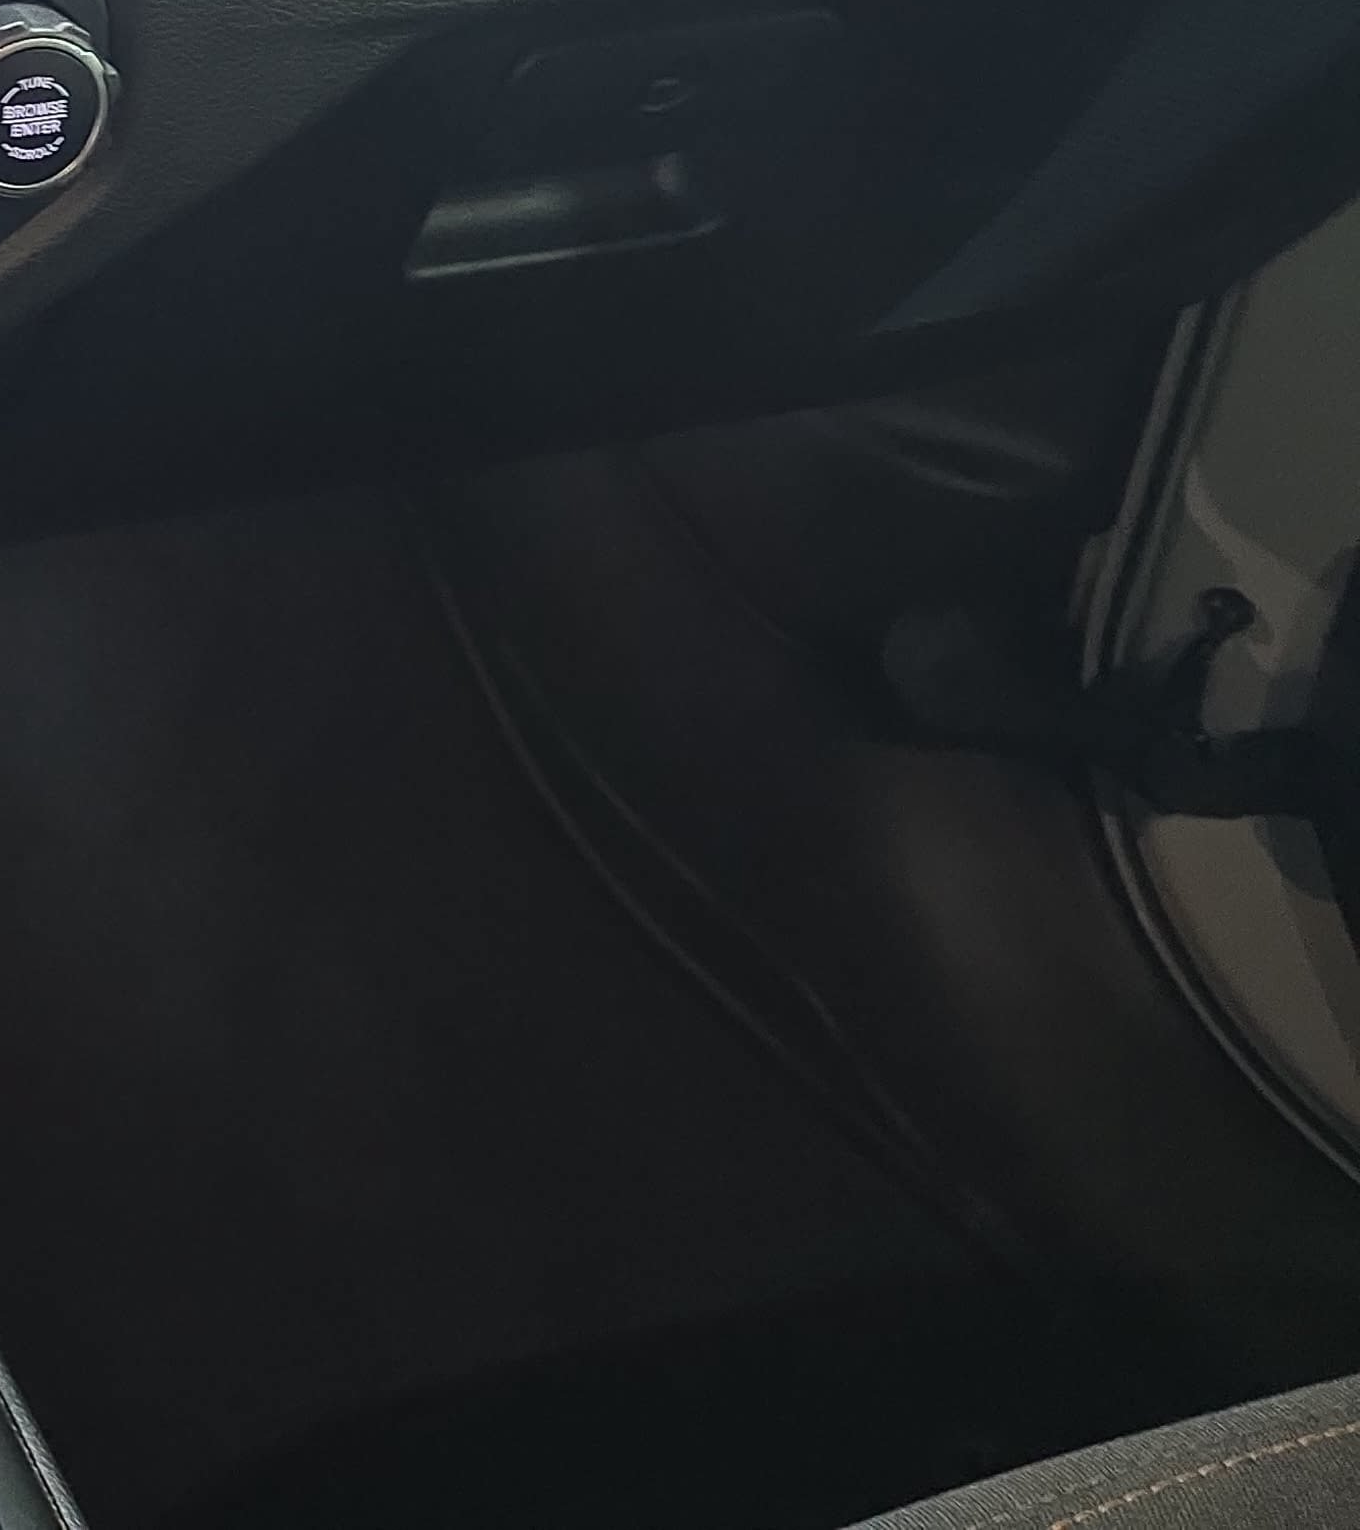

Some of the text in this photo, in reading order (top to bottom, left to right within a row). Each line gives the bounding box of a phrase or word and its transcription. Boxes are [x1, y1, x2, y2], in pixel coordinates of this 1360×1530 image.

[17, 76, 56, 91] TUNE
[1, 99, 69, 119] BROWSE
[10, 119, 62, 138] ENTER
